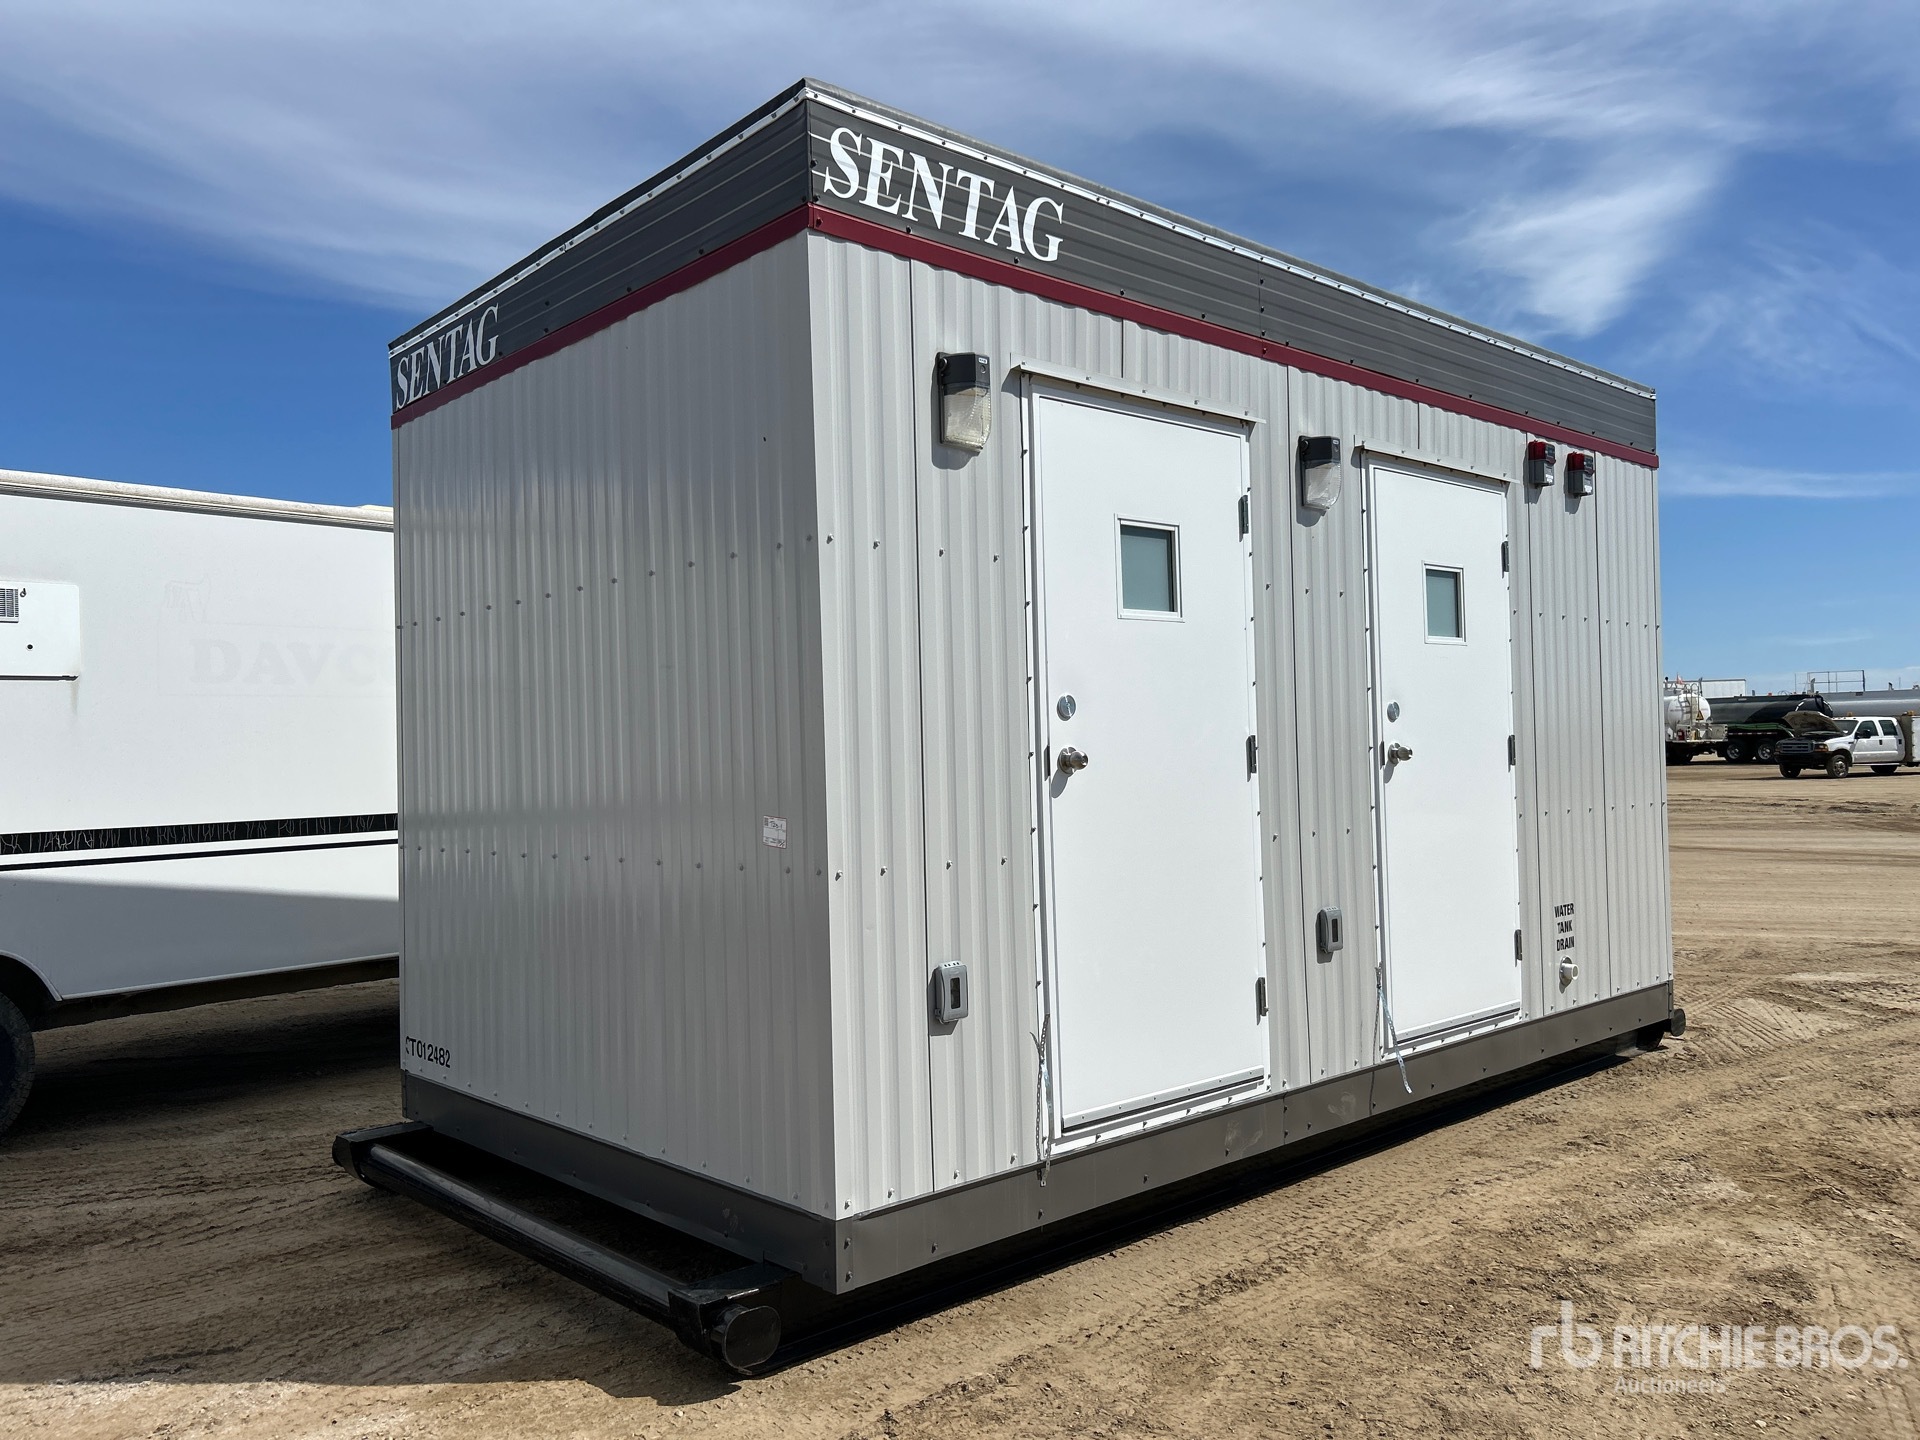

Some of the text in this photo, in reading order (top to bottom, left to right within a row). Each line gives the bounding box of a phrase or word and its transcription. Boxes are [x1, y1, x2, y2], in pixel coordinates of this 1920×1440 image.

[825, 127, 1064, 262] SENTAG
[396, 303, 499, 410] SENTAG
[1554, 903, 1574, 918] WATER
[1557, 920, 1573, 934] TANK
[1556, 936, 1575, 951] DRAIN
